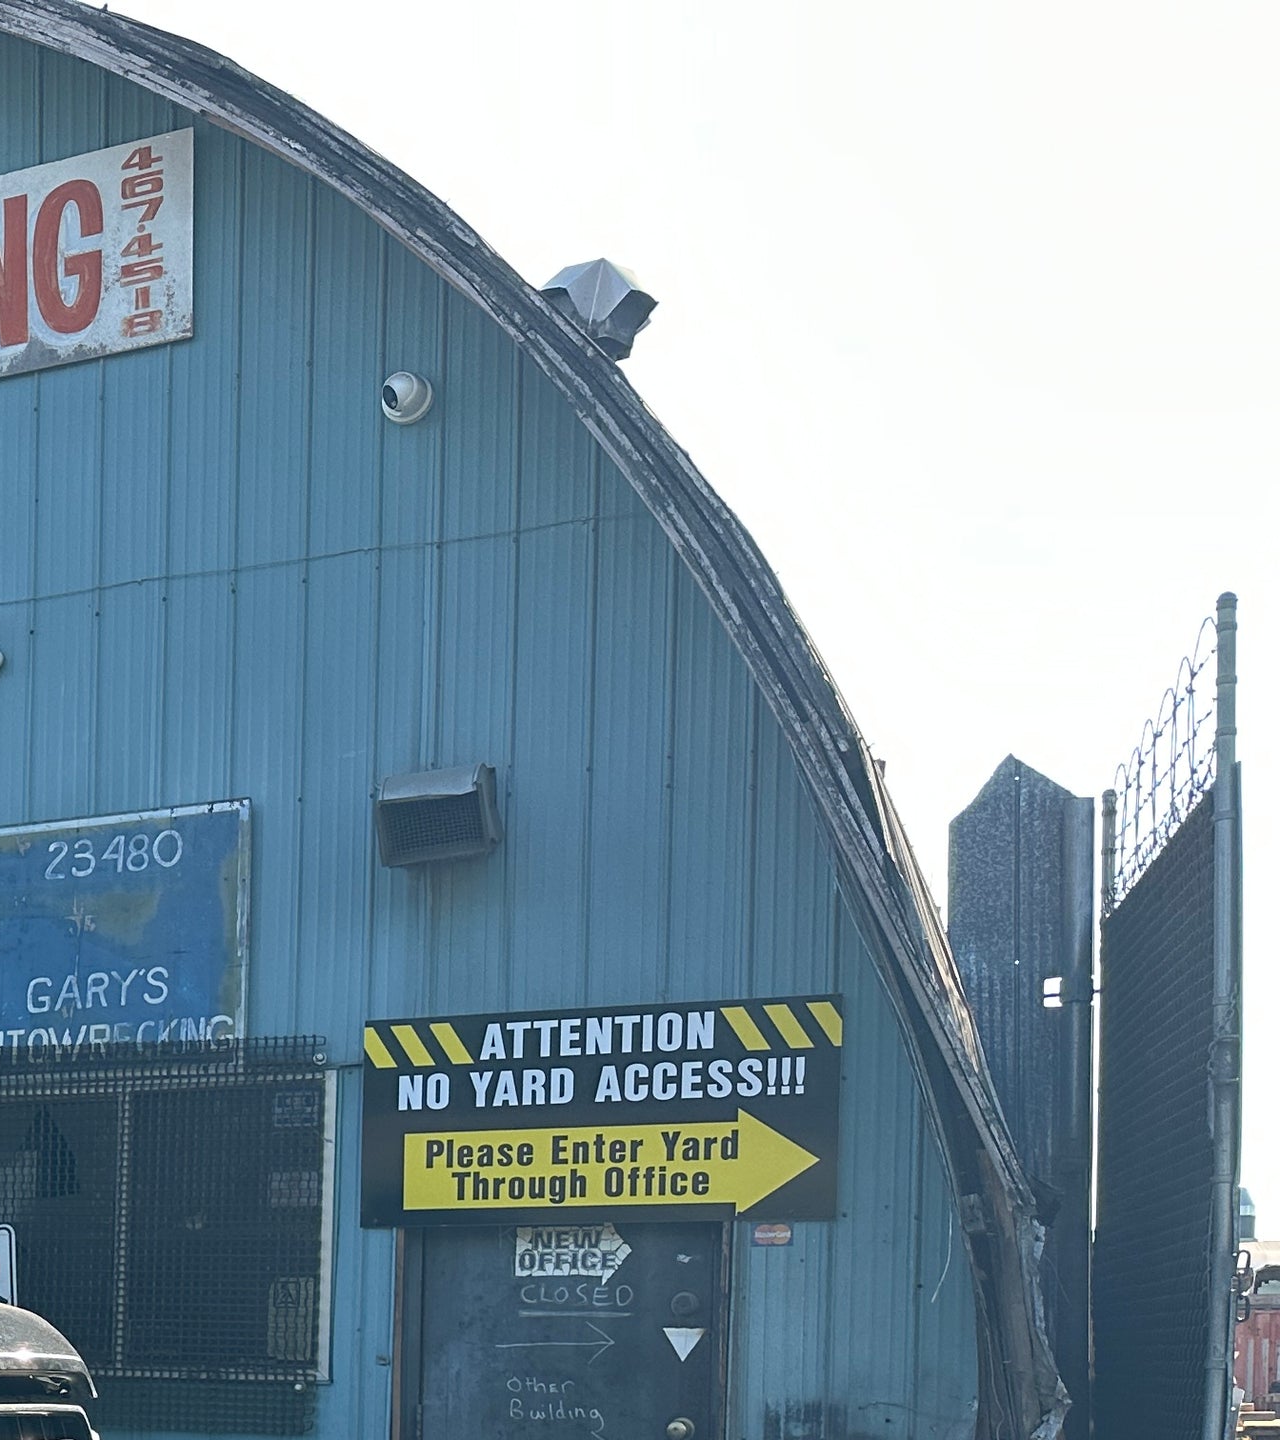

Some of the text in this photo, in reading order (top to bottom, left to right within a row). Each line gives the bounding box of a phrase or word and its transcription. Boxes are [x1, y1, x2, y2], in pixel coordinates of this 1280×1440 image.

[44, 829, 183, 880] 23480
[27, 966, 169, 1014] GARY'S
[479, 1010, 715, 1061] ATTENTION
[397, 1056, 807, 1111] NO YARD ACCESS!!!
[425, 1129, 740, 1169] Please Enter Yard
[451, 1165, 710, 1204] Through Office
[530, 1228, 602, 1250] NEW
[518, 1249, 619, 1273] OFFICE
[520, 1283, 634, 1306] CLOSED
[509, 1398, 604, 1433] Building
